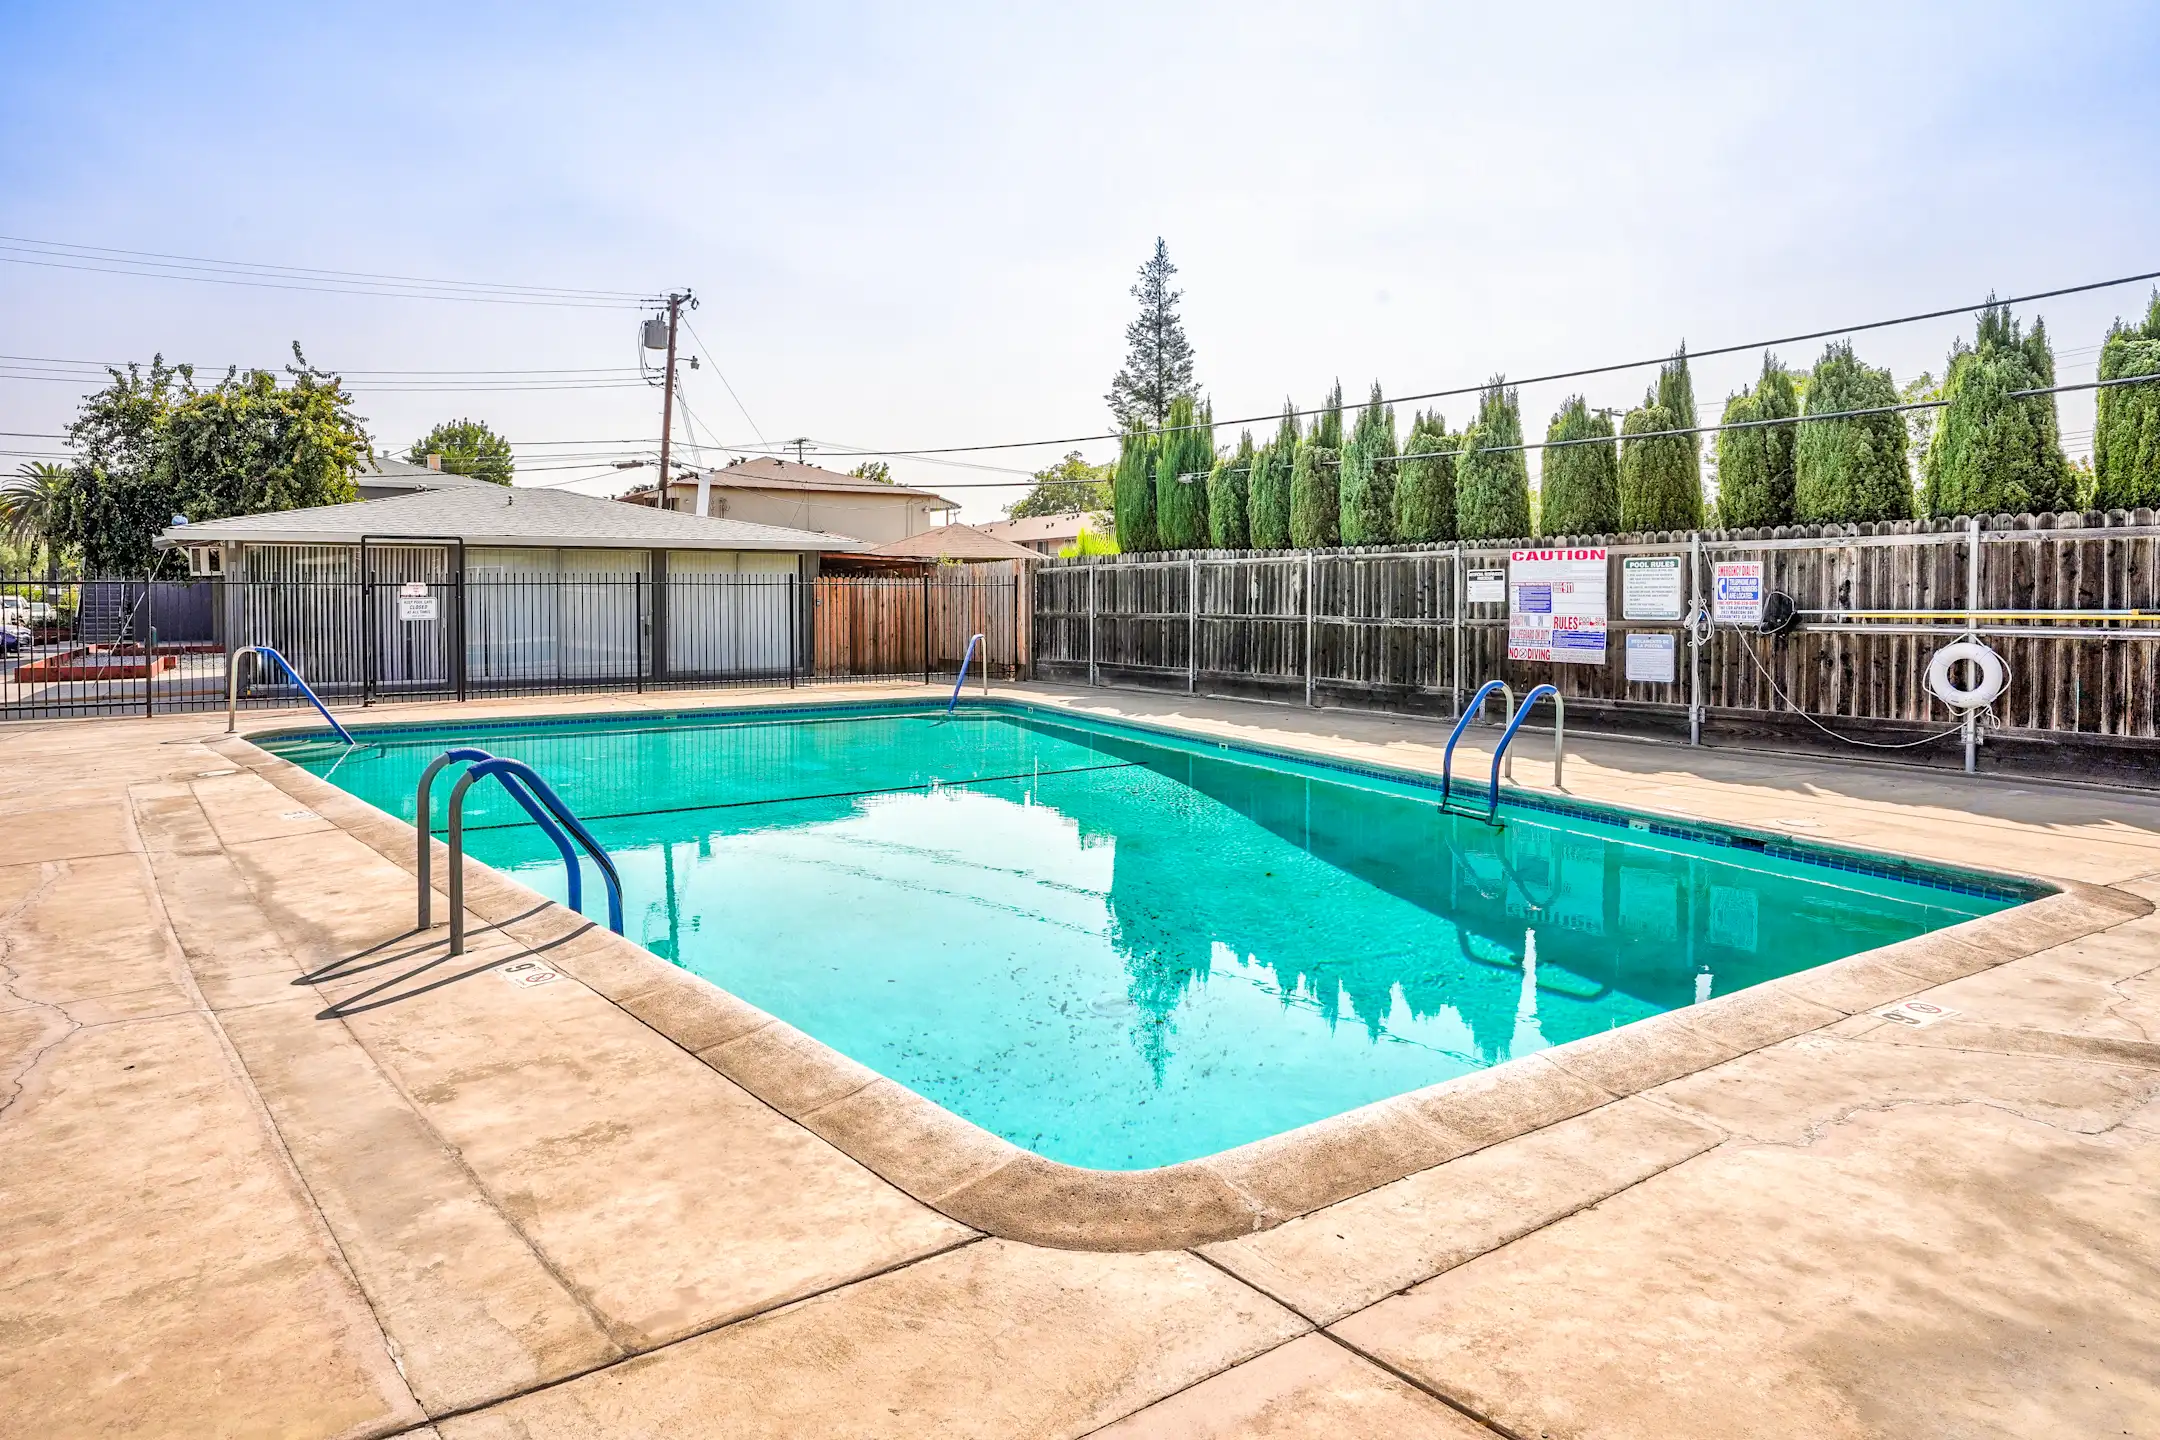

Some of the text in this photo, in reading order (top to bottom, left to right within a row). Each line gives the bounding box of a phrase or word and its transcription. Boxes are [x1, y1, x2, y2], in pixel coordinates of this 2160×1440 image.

[1512, 549, 1606, 561] CAUTION
[1718, 565, 1741, 576] EMERGENCY
[1742, 565, 1751, 576] DIAL
[1562, 582, 1572, 593] 911
[1554, 616, 1578, 629] RULES
[1510, 648, 1518, 658] NO
[1528, 648, 1550, 660] DIVING
